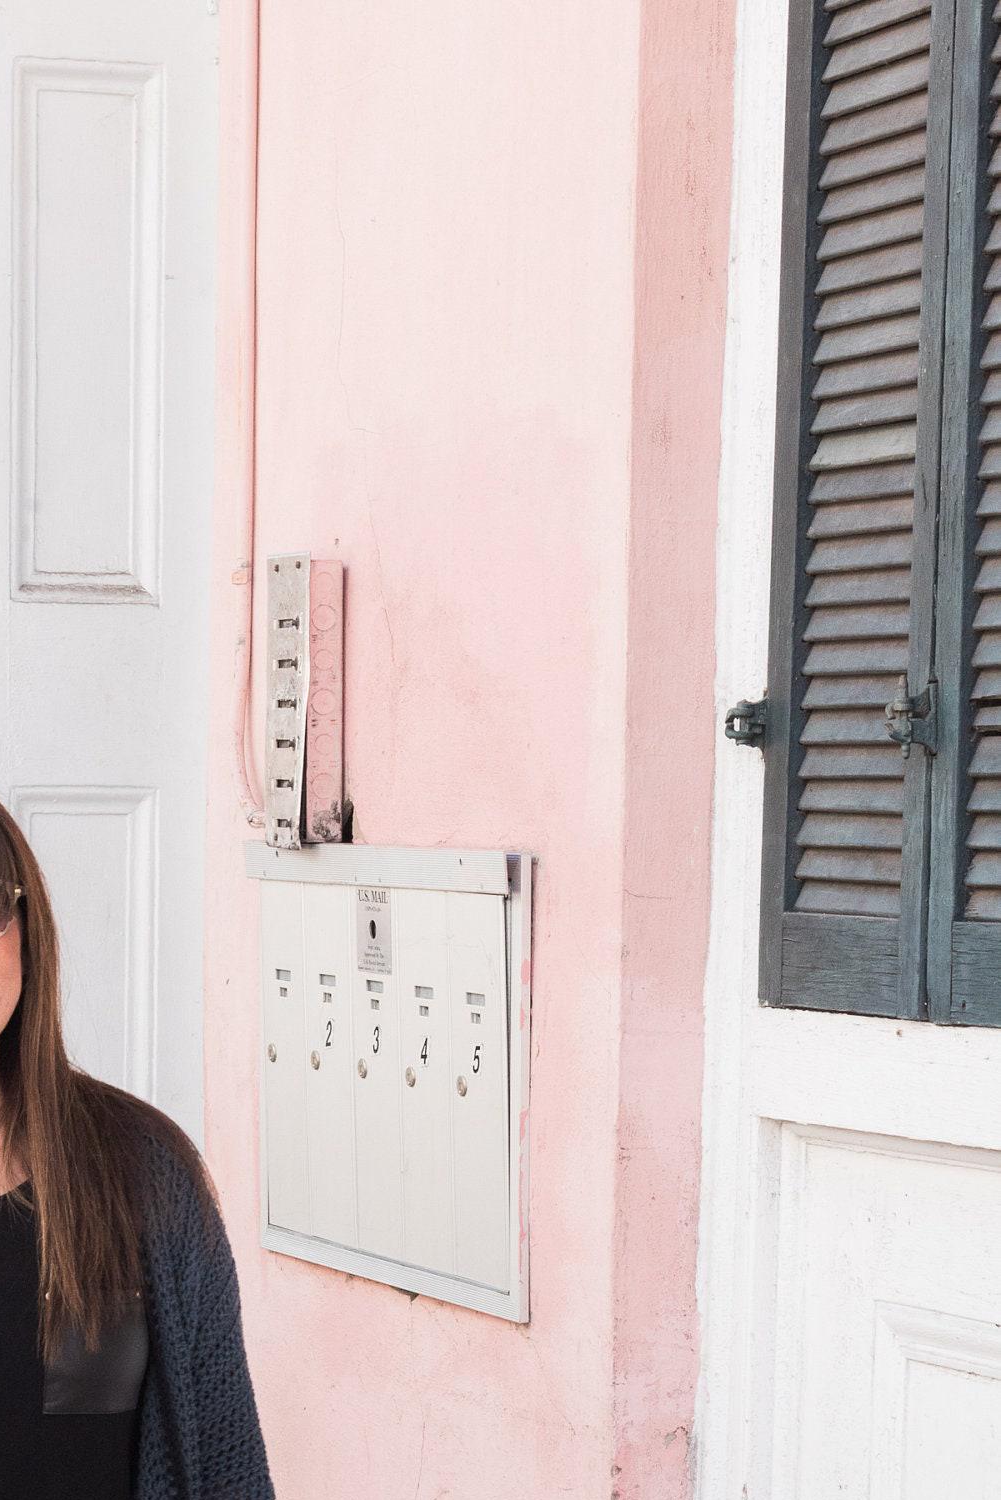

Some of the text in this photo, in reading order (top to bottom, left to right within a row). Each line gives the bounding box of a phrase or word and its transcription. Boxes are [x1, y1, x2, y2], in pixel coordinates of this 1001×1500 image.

[371, 890, 388, 904] MAIL
[325, 1021, 333, 1047] 2
[373, 1026, 380, 1054] 3
[420, 1037, 428, 1065] 4
[472, 1045, 481, 1074] 5
